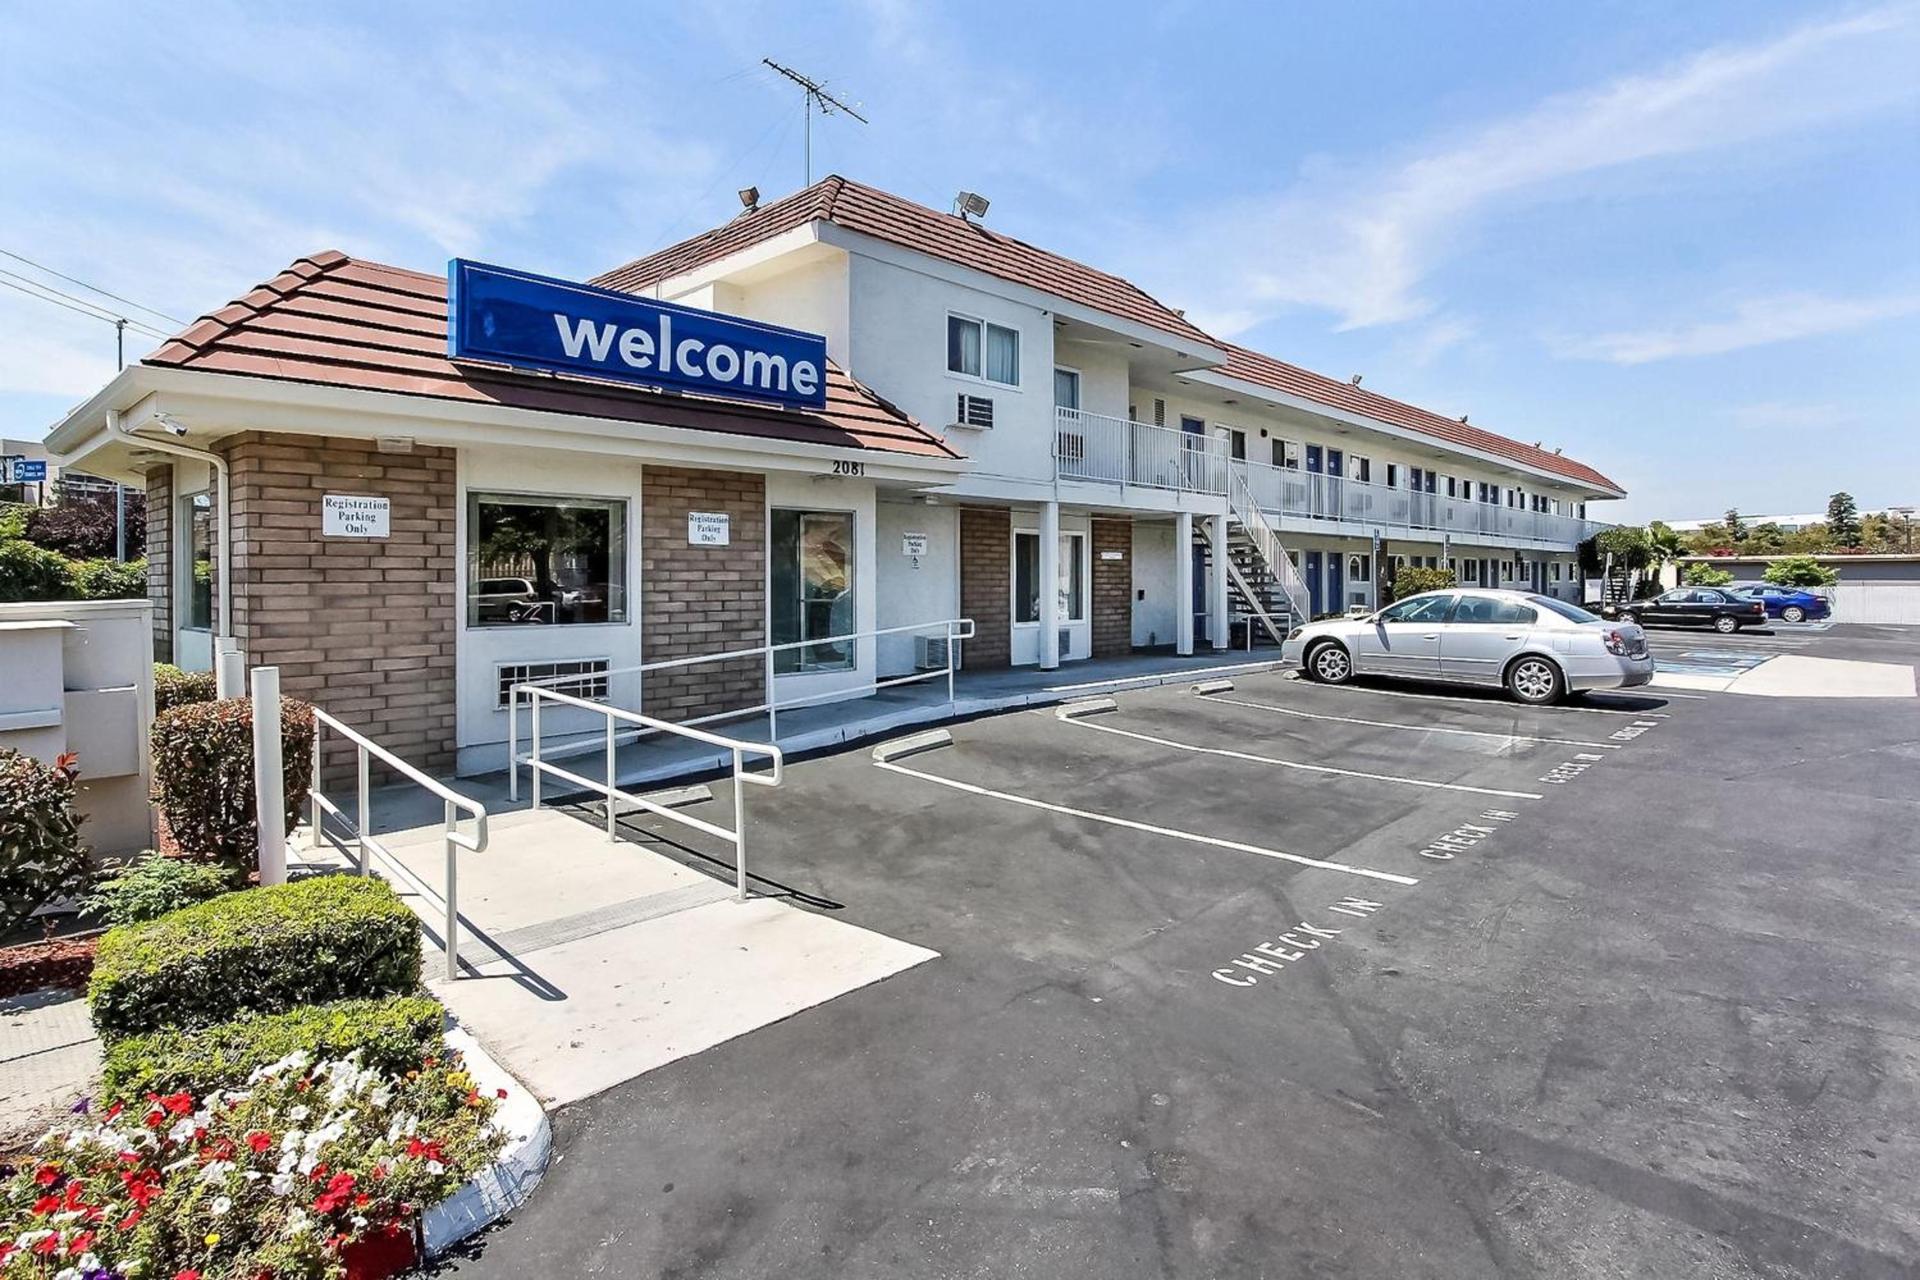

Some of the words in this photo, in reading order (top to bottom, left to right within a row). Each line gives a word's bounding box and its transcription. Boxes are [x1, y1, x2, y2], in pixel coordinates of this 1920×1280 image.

[554, 314, 819, 396] welcome
[833, 460, 865, 476] 2081
[325, 497, 388, 510] Registration
[338, 511, 376, 524] Parking
[345, 524, 368, 535] Only
[1419, 822, 1497, 860] CHECK
[1479, 808, 1519, 822] IN
[1211, 921, 1342, 987] CHECK
[1328, 896, 1383, 917] IN
